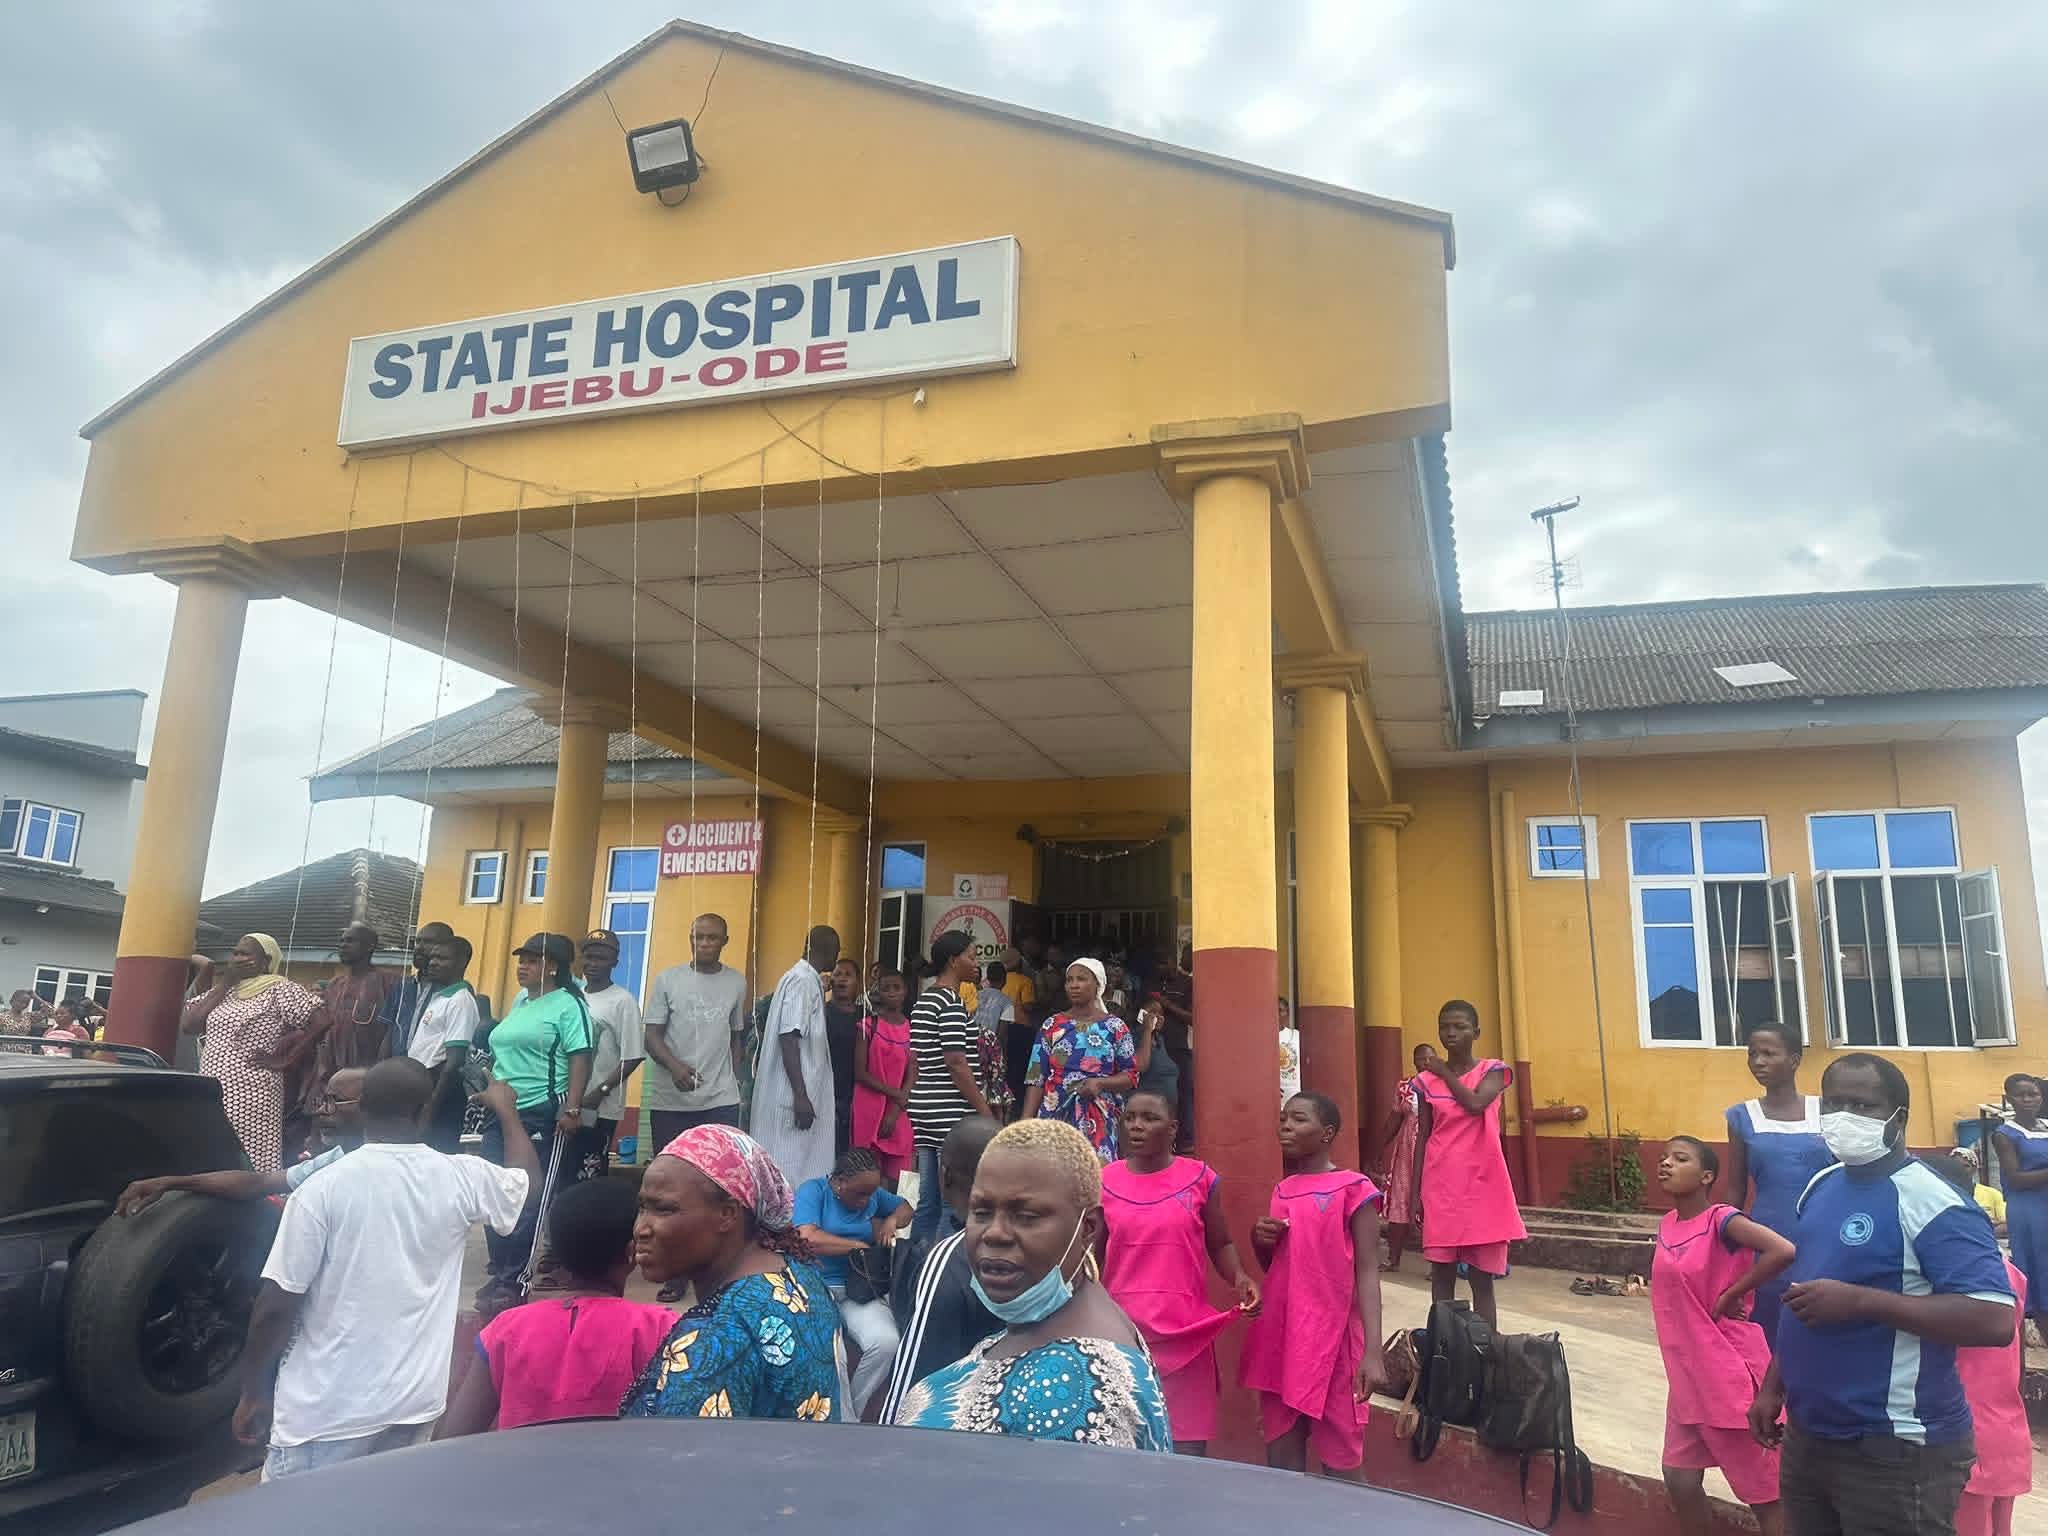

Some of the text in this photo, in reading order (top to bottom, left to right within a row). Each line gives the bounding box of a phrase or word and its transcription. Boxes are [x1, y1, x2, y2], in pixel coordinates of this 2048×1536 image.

[368, 258, 980, 399] STATE HOSPITAL
[472, 341, 848, 418] IJEBU-ODE
[687, 821, 752, 847] ACCIDENT
[663, 849, 758, 874] EMERGENCY
